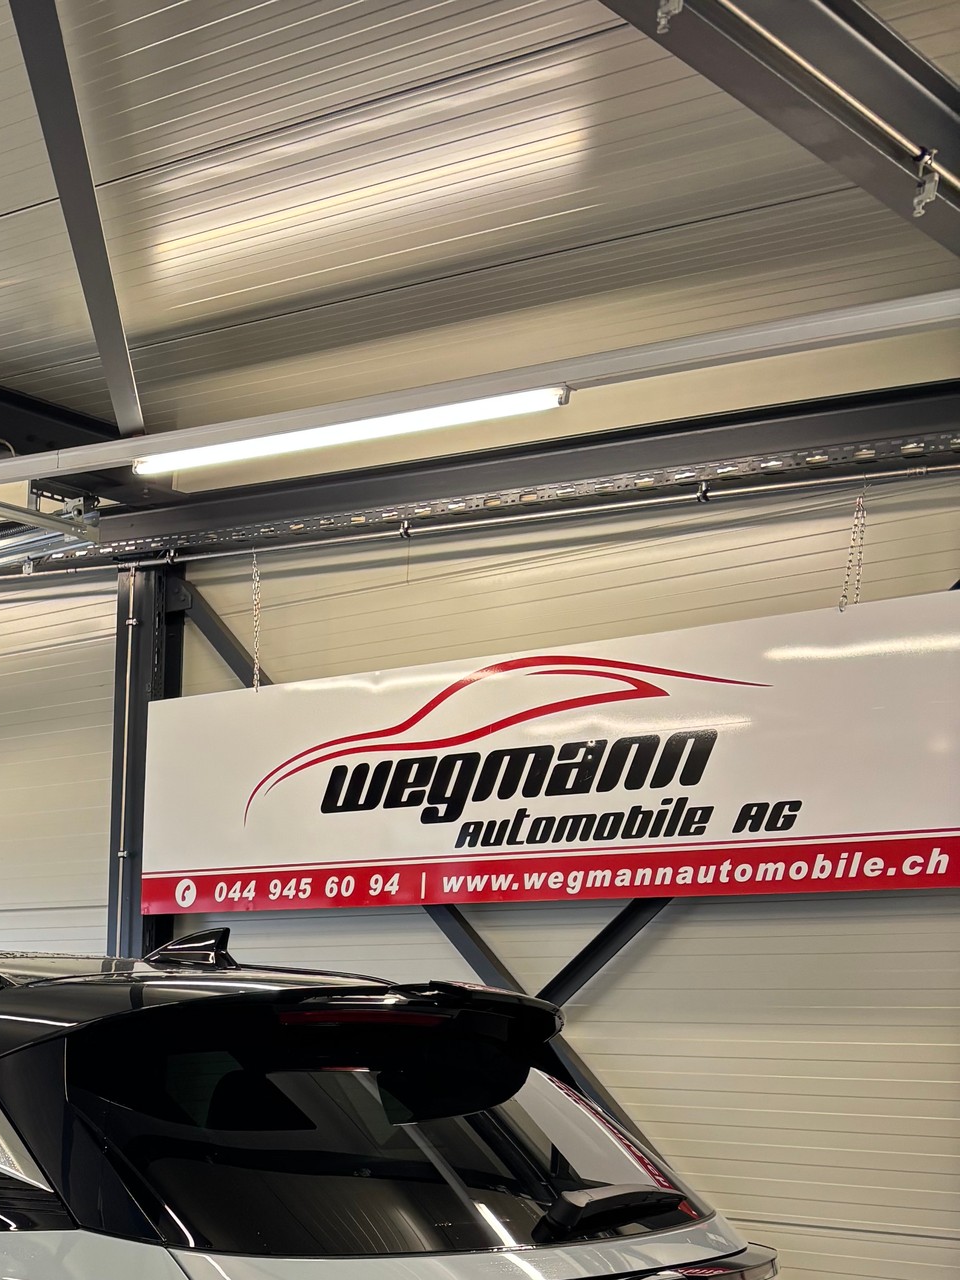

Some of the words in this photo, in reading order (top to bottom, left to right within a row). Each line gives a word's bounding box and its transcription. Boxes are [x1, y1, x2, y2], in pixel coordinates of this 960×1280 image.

[321, 728, 718, 824] wegmann
[732, 800, 803, 834] AG
[214, 880, 257, 903] 044
[268, 877, 313, 901] 945
[324, 875, 356, 898] 60
[368, 872, 401, 896] 94
[442, 848, 950, 894] www.wegmannautomobile.ch
